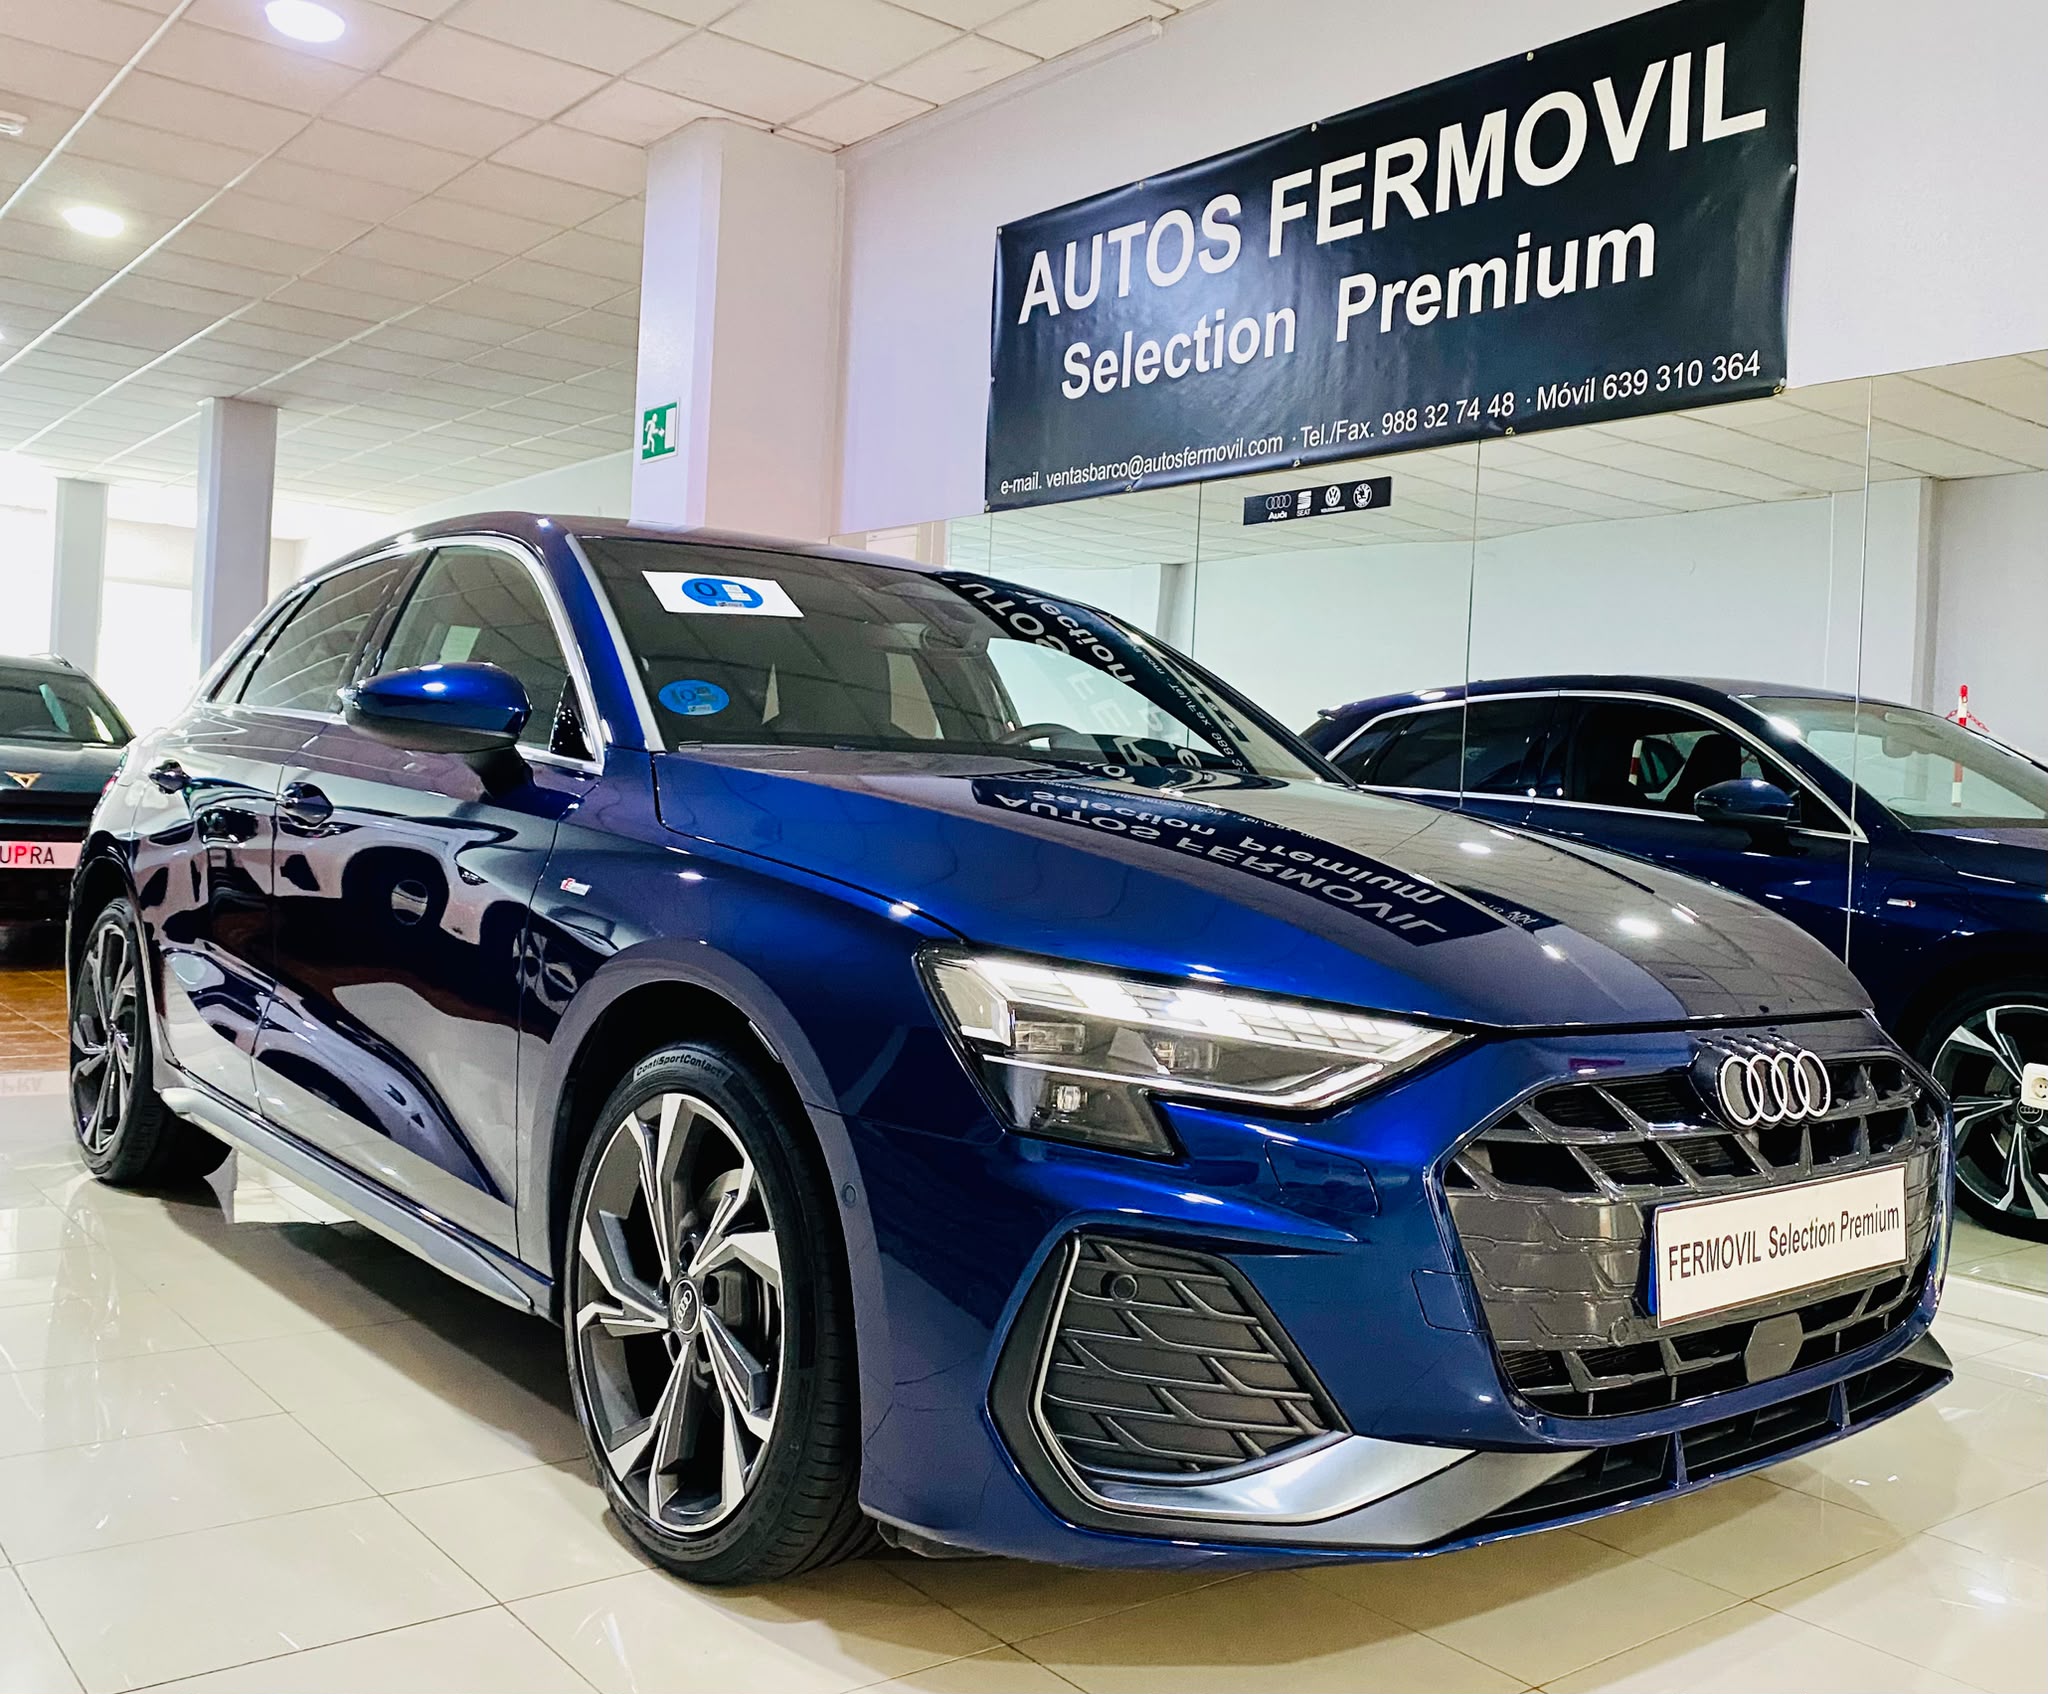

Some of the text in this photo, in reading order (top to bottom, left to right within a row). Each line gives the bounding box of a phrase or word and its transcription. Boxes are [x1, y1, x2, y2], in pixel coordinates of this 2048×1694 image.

[1018, 42, 1767, 324] AUTOS FERMOVIL
[1061, 221, 1656, 400] Selection Premium
[1000, 349, 1761, 495] e-mail. ventasbarco@autosfermovil.com Tel./Fax. 988 32 74 48 Móvil 639 310 364
[1268, 511, 1288, 521] Audi
[1296, 508, 1311, 517] SEAT
[1669, 1203, 1900, 1282] FERMOVIL Selection Premium
